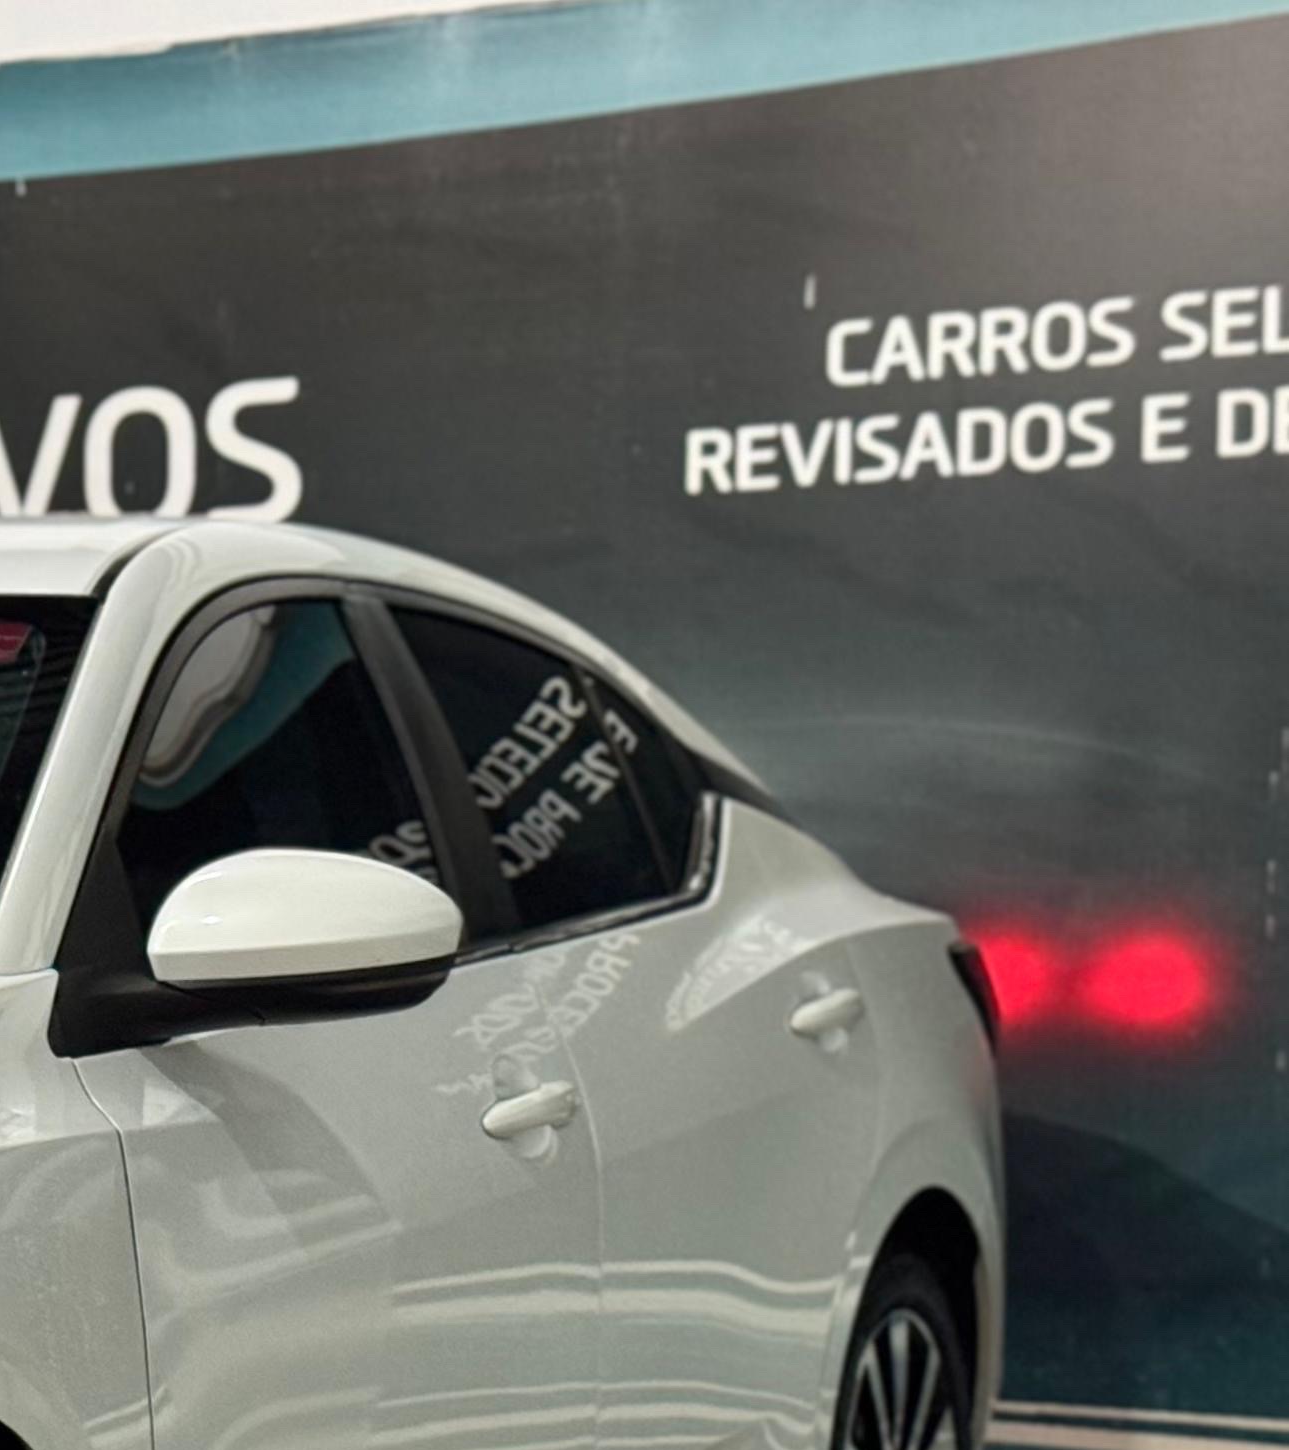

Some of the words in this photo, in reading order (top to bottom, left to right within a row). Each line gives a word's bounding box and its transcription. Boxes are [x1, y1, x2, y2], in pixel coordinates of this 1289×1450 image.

[825, 294, 1136, 387] CARROS
[1159, 284, 1289, 363] SEL
[683, 397, 1116, 497] REVISADOS
[1140, 392, 1191, 464] E
